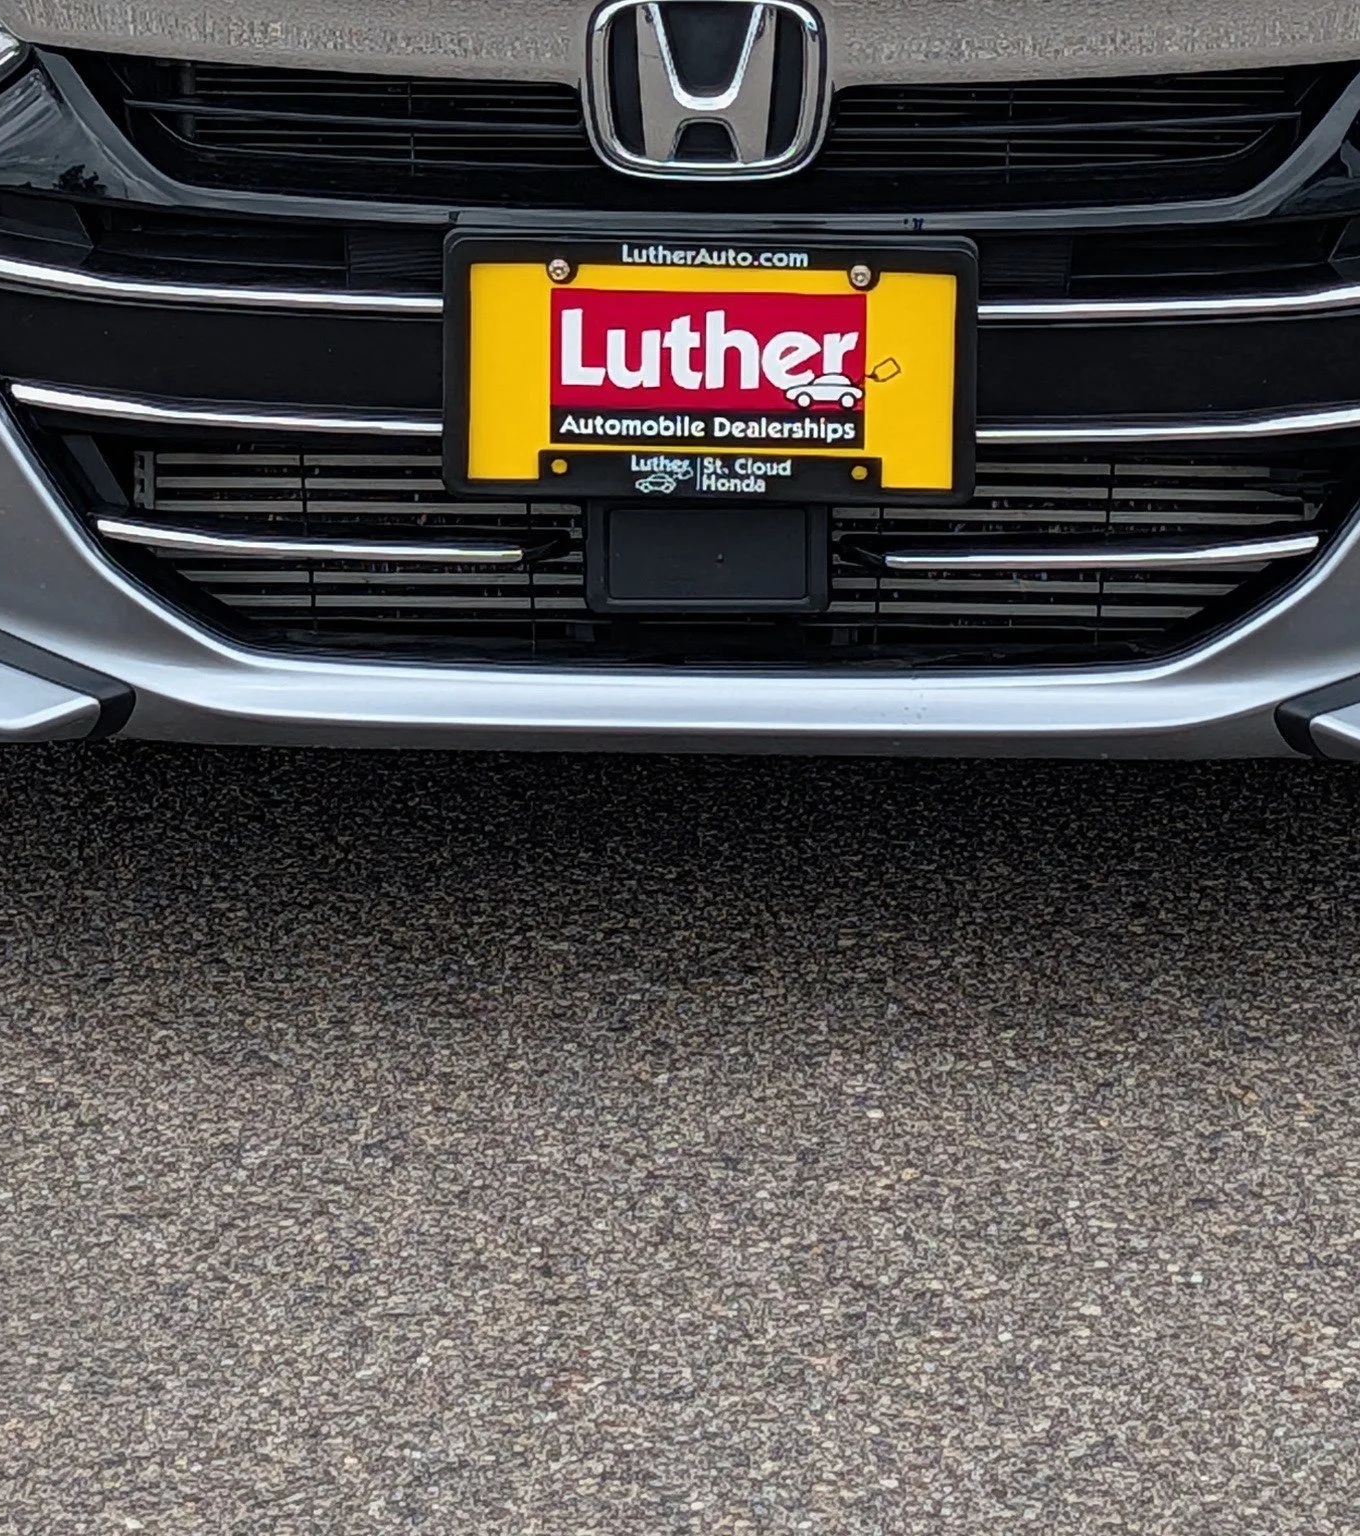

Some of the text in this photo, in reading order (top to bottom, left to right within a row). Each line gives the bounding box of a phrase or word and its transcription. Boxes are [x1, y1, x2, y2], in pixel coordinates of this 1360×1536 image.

[622, 244, 809, 268] LutherAuto.com
[561, 308, 859, 391] Luther
[559, 415, 856, 443] Automobile Dealerships
[703, 457, 792, 476] St. Cloud
[702, 474, 766, 493] Honda
